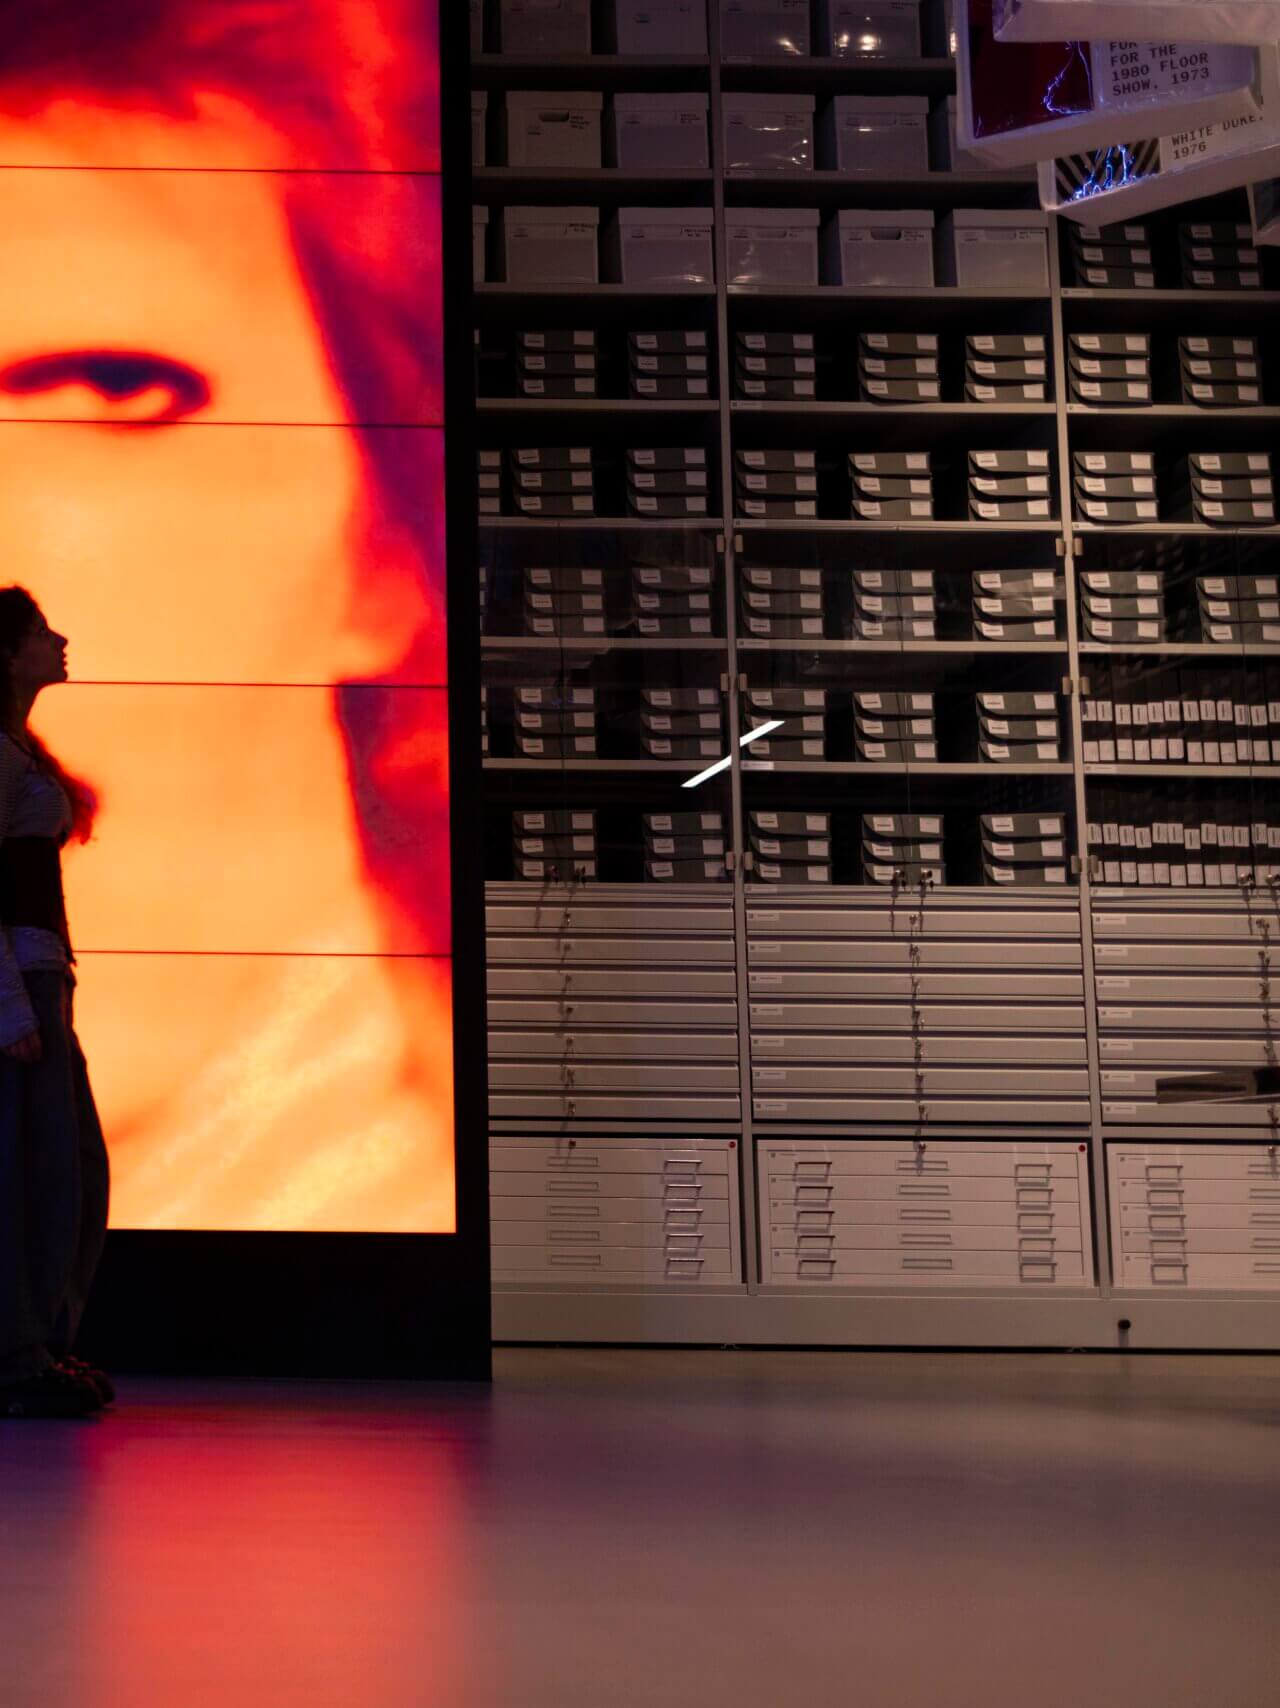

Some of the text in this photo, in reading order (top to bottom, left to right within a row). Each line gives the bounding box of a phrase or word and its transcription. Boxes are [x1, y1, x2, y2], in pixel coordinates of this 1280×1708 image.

[1110, 43, 1177, 67] FOR THE
[1112, 52, 1209, 82] 1980 FLOOR
[1112, 67, 1210, 97] SHOW. 1973
[1171, 125, 1214, 147] WHITE
[1173, 142, 1207, 160] 1976
